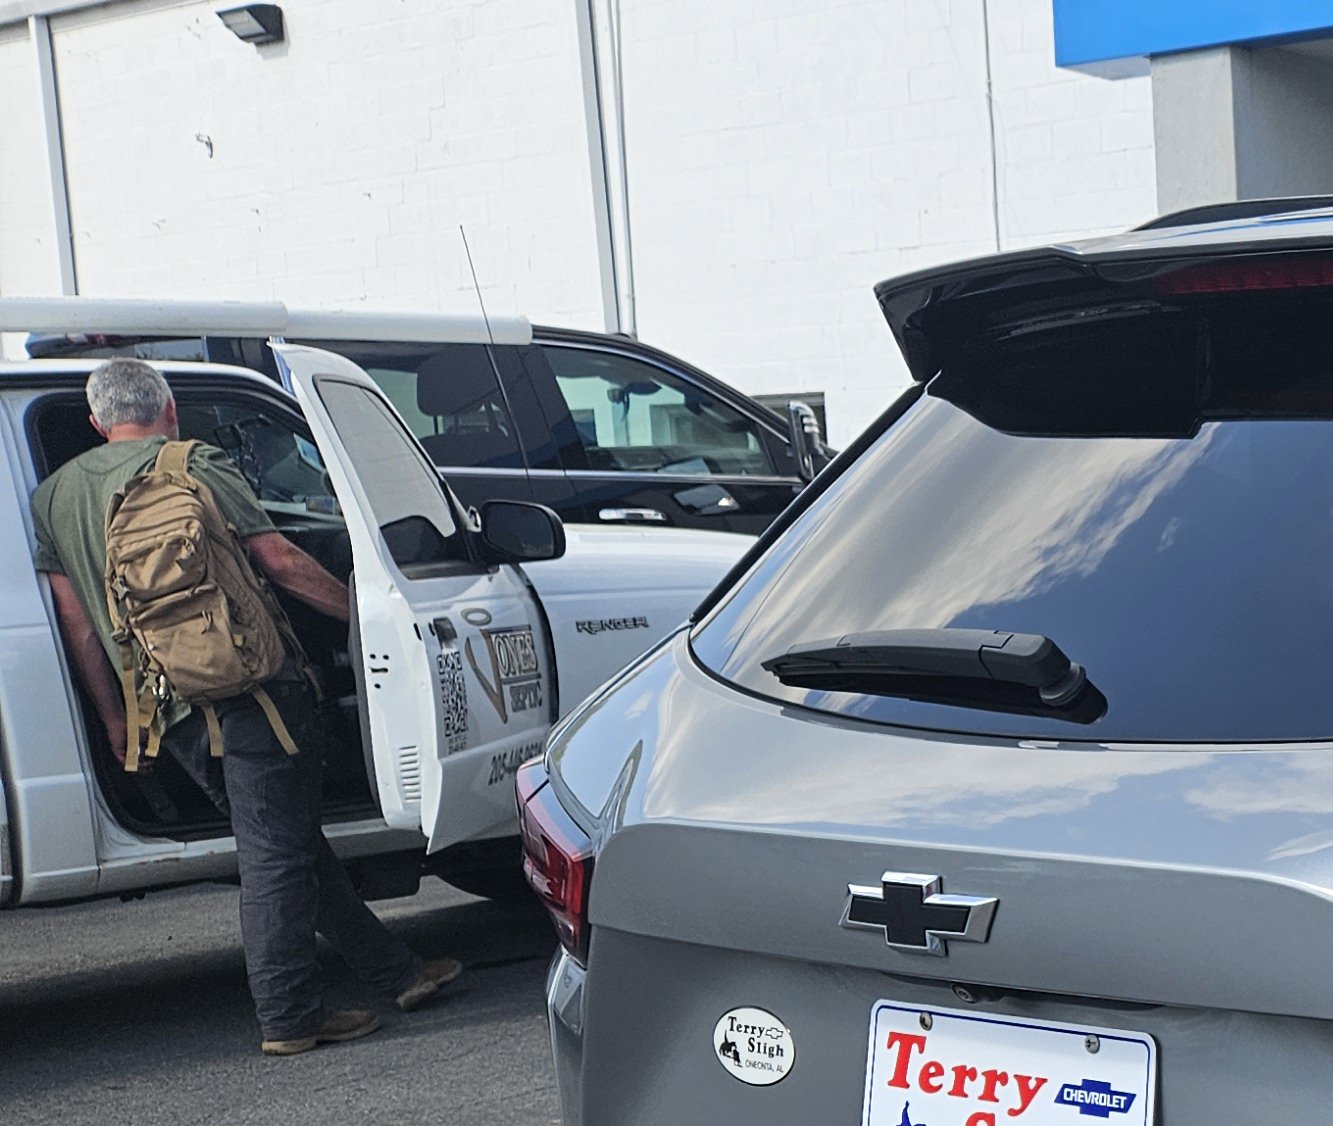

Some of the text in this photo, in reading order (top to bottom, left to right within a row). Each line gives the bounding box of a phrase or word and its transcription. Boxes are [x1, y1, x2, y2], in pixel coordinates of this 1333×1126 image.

[728, 1016, 765, 1038] Terry
[747, 1037, 784, 1058] Sligh
[776, 1064, 784, 1073] AL
[887, 1032, 1048, 1117] Terry
[1063, 1087, 1128, 1109] CHEVROLET
